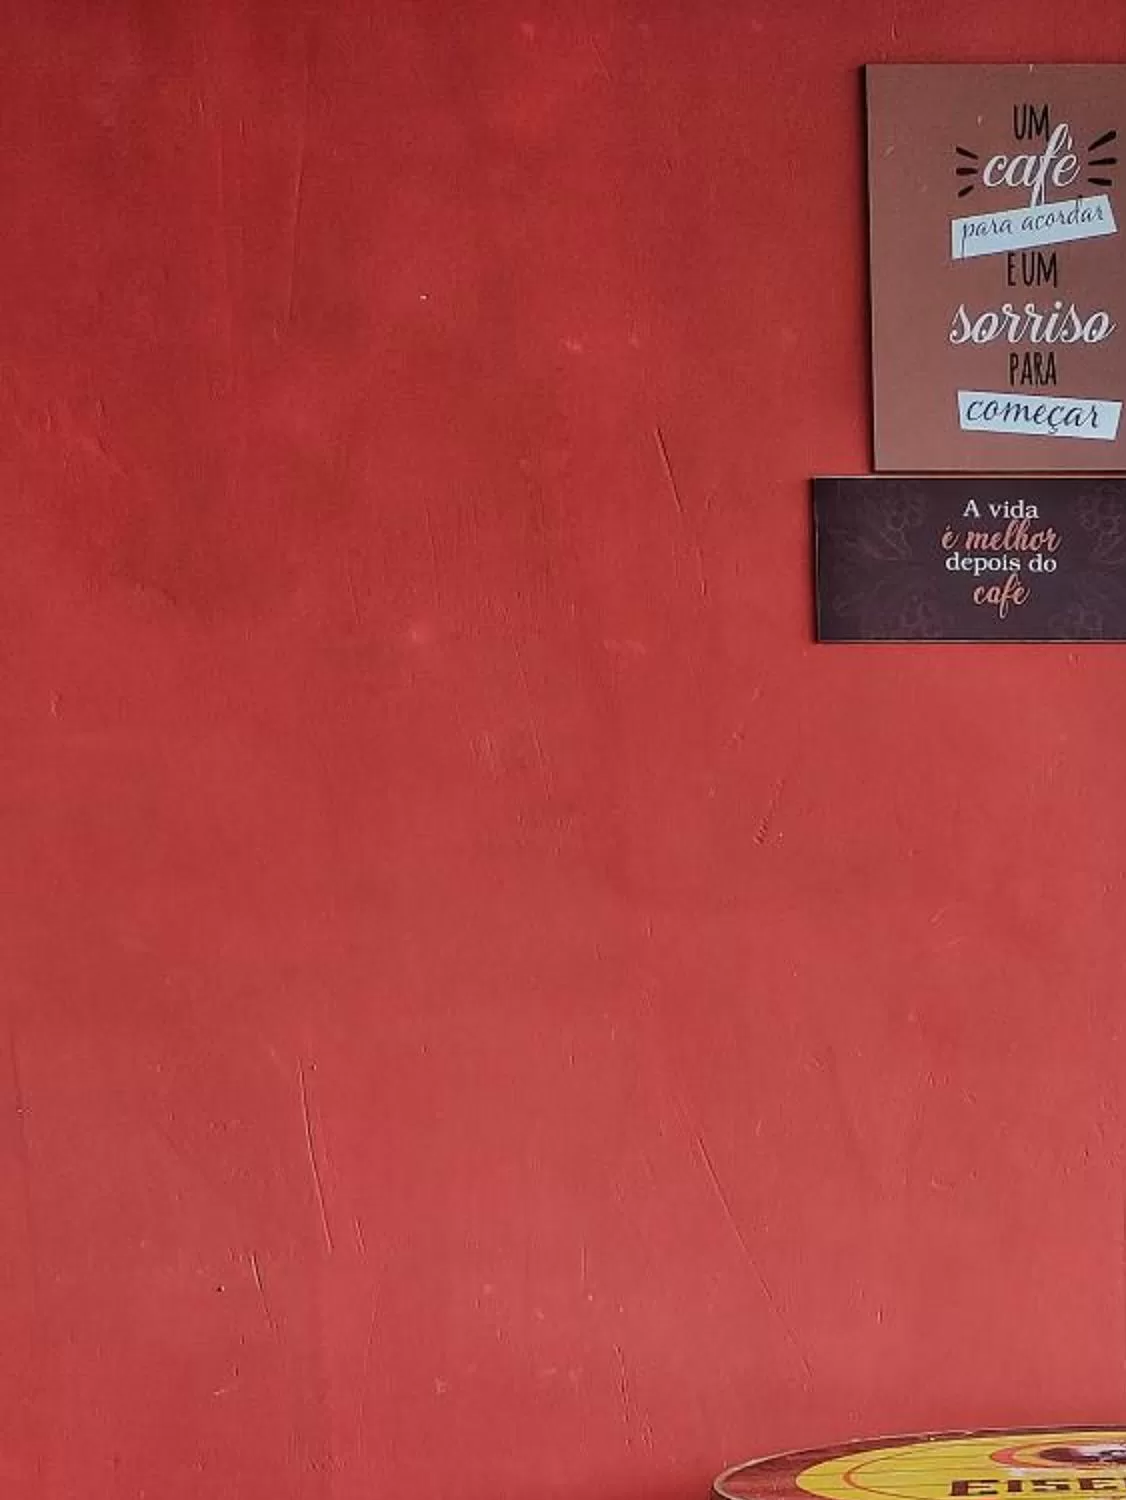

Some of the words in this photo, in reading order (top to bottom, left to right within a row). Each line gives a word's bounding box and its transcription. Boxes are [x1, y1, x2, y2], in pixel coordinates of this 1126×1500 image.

[1012, 103, 1050, 140] UM
[982, 122, 1081, 208] café
[960, 218, 1014, 261] para
[1020, 194, 1105, 232] acordar
[1006, 251, 1017, 286] E
[1021, 251, 1058, 288] UM
[948, 300, 1118, 345] sorriso
[1008, 350, 1058, 386] PARA
[964, 397, 1101, 434] começar
[962, 499, 982, 518] A
[988, 499, 1040, 519] vida
[940, 523, 960, 551] é
[964, 517, 1062, 552] melhor
[945, 552, 1022, 577] depois
[1028, 552, 1058, 573] do
[972, 571, 1032, 620] café
